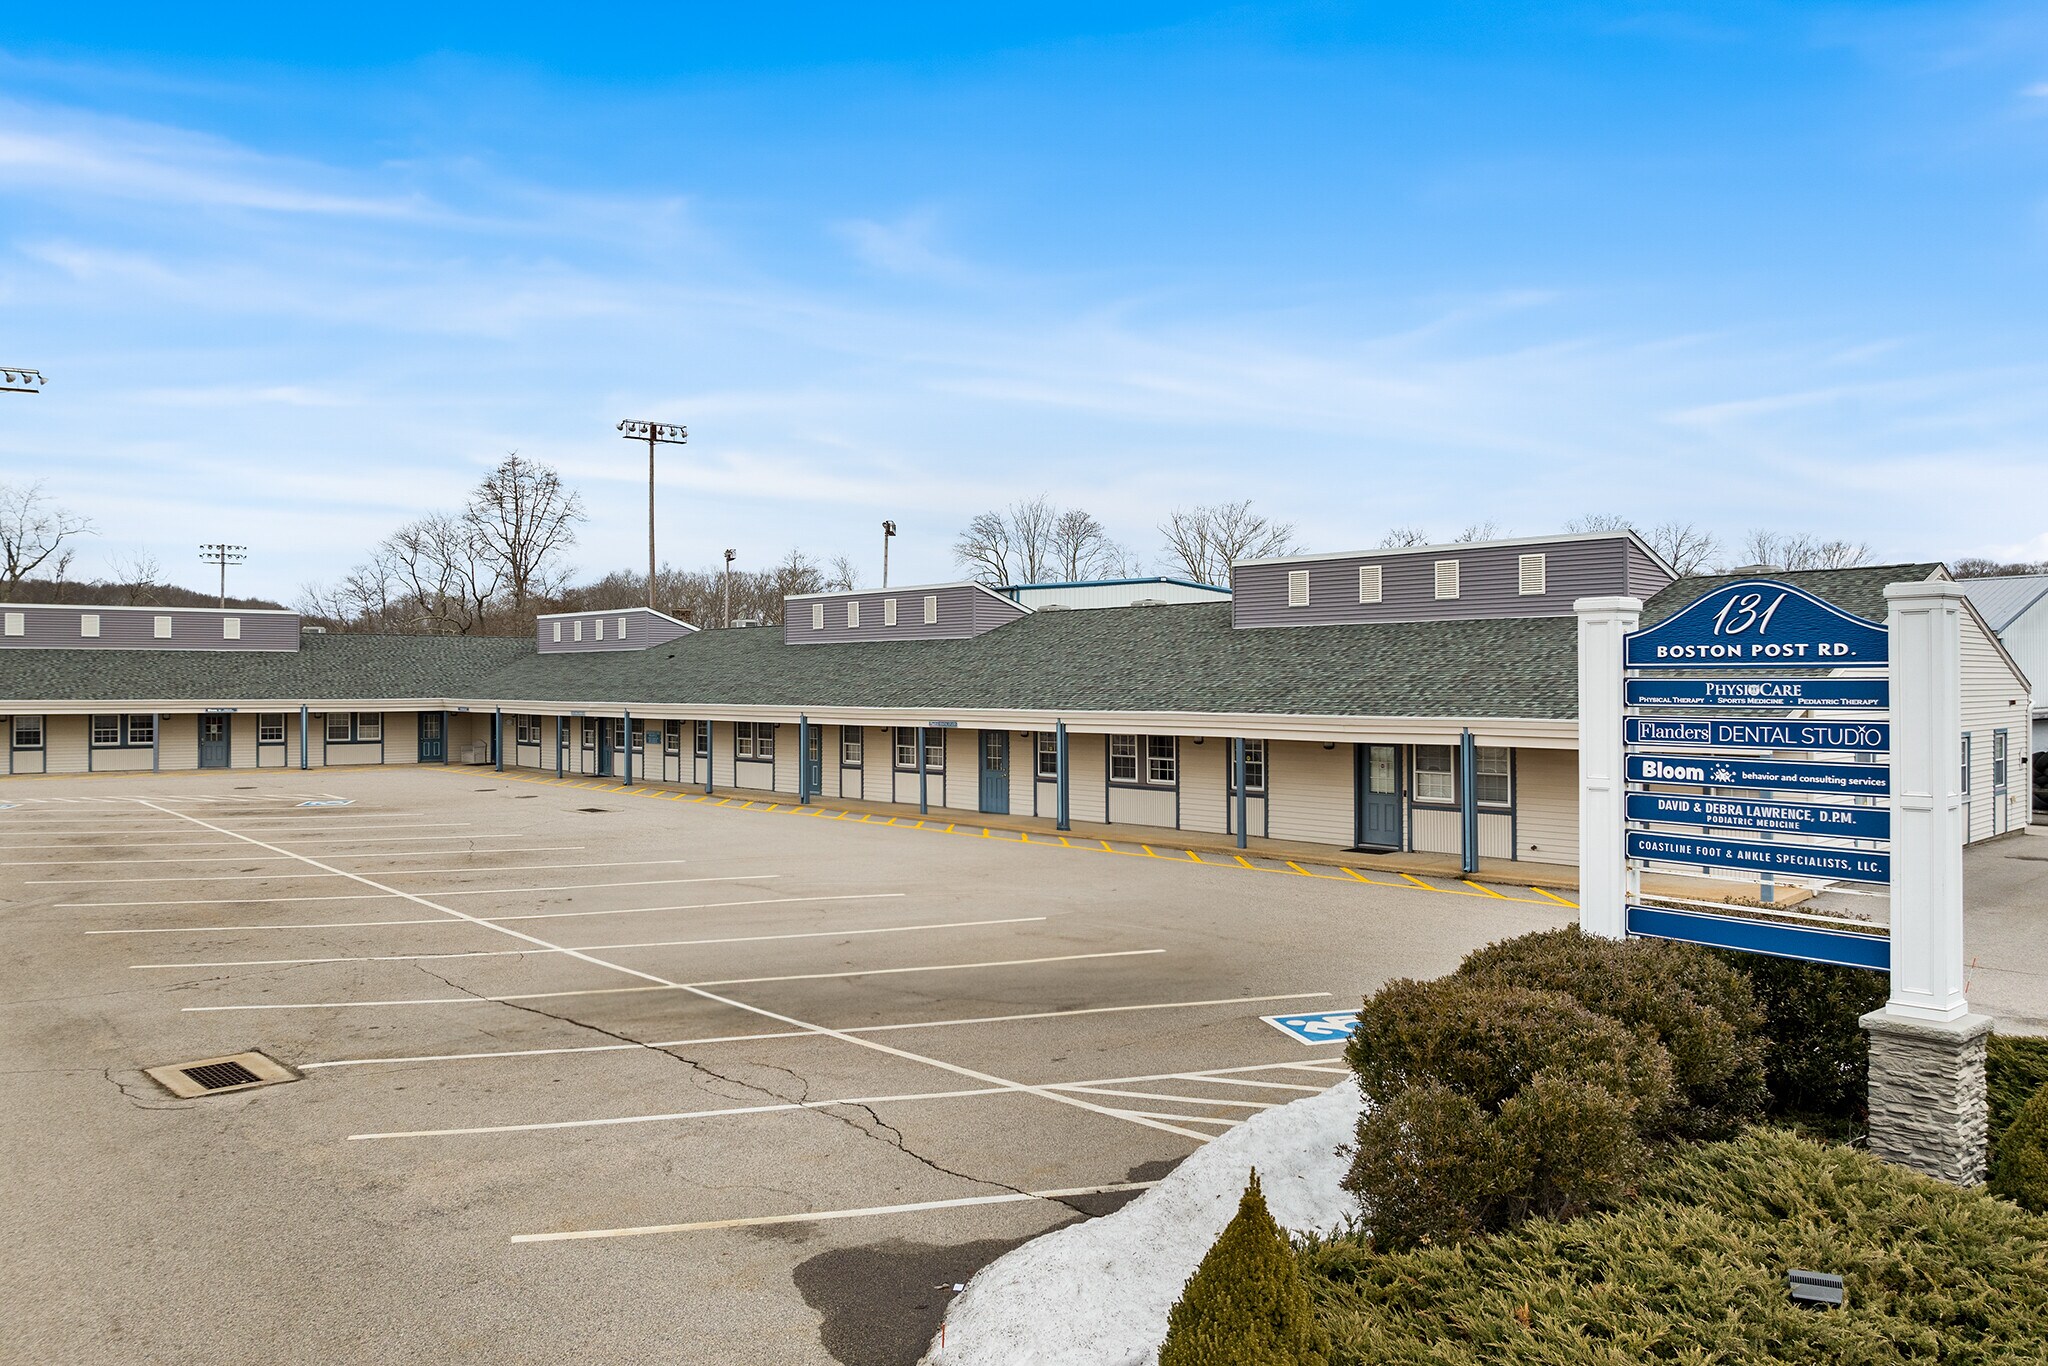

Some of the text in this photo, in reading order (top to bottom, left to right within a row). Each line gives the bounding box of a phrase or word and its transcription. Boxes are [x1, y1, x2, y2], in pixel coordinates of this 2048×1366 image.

[1712, 593, 1788, 635] 131
[1657, 643, 1857, 658] BOSTON POST RD.
[1638, 696, 1672, 704] PHYSICAL
[1747, 697, 1784, 705] MEDICINE
[1839, 698, 1879, 706] THERAPY
[1640, 723, 1709, 740] Flanders
[1718, 725, 1797, 744] DENTAL
[1642, 760, 1886, 787] Bloom behavior and consulting services
[1658, 799, 1857, 824] DAVID & DEBRA LAWRENCE, D.P.M.
[1707, 816, 1800, 830] PODIATRIC MEDICINE
[1639, 840, 1882, 873] COASTLINE FOOT & ANKLE SPECIALISTS, LLC.
